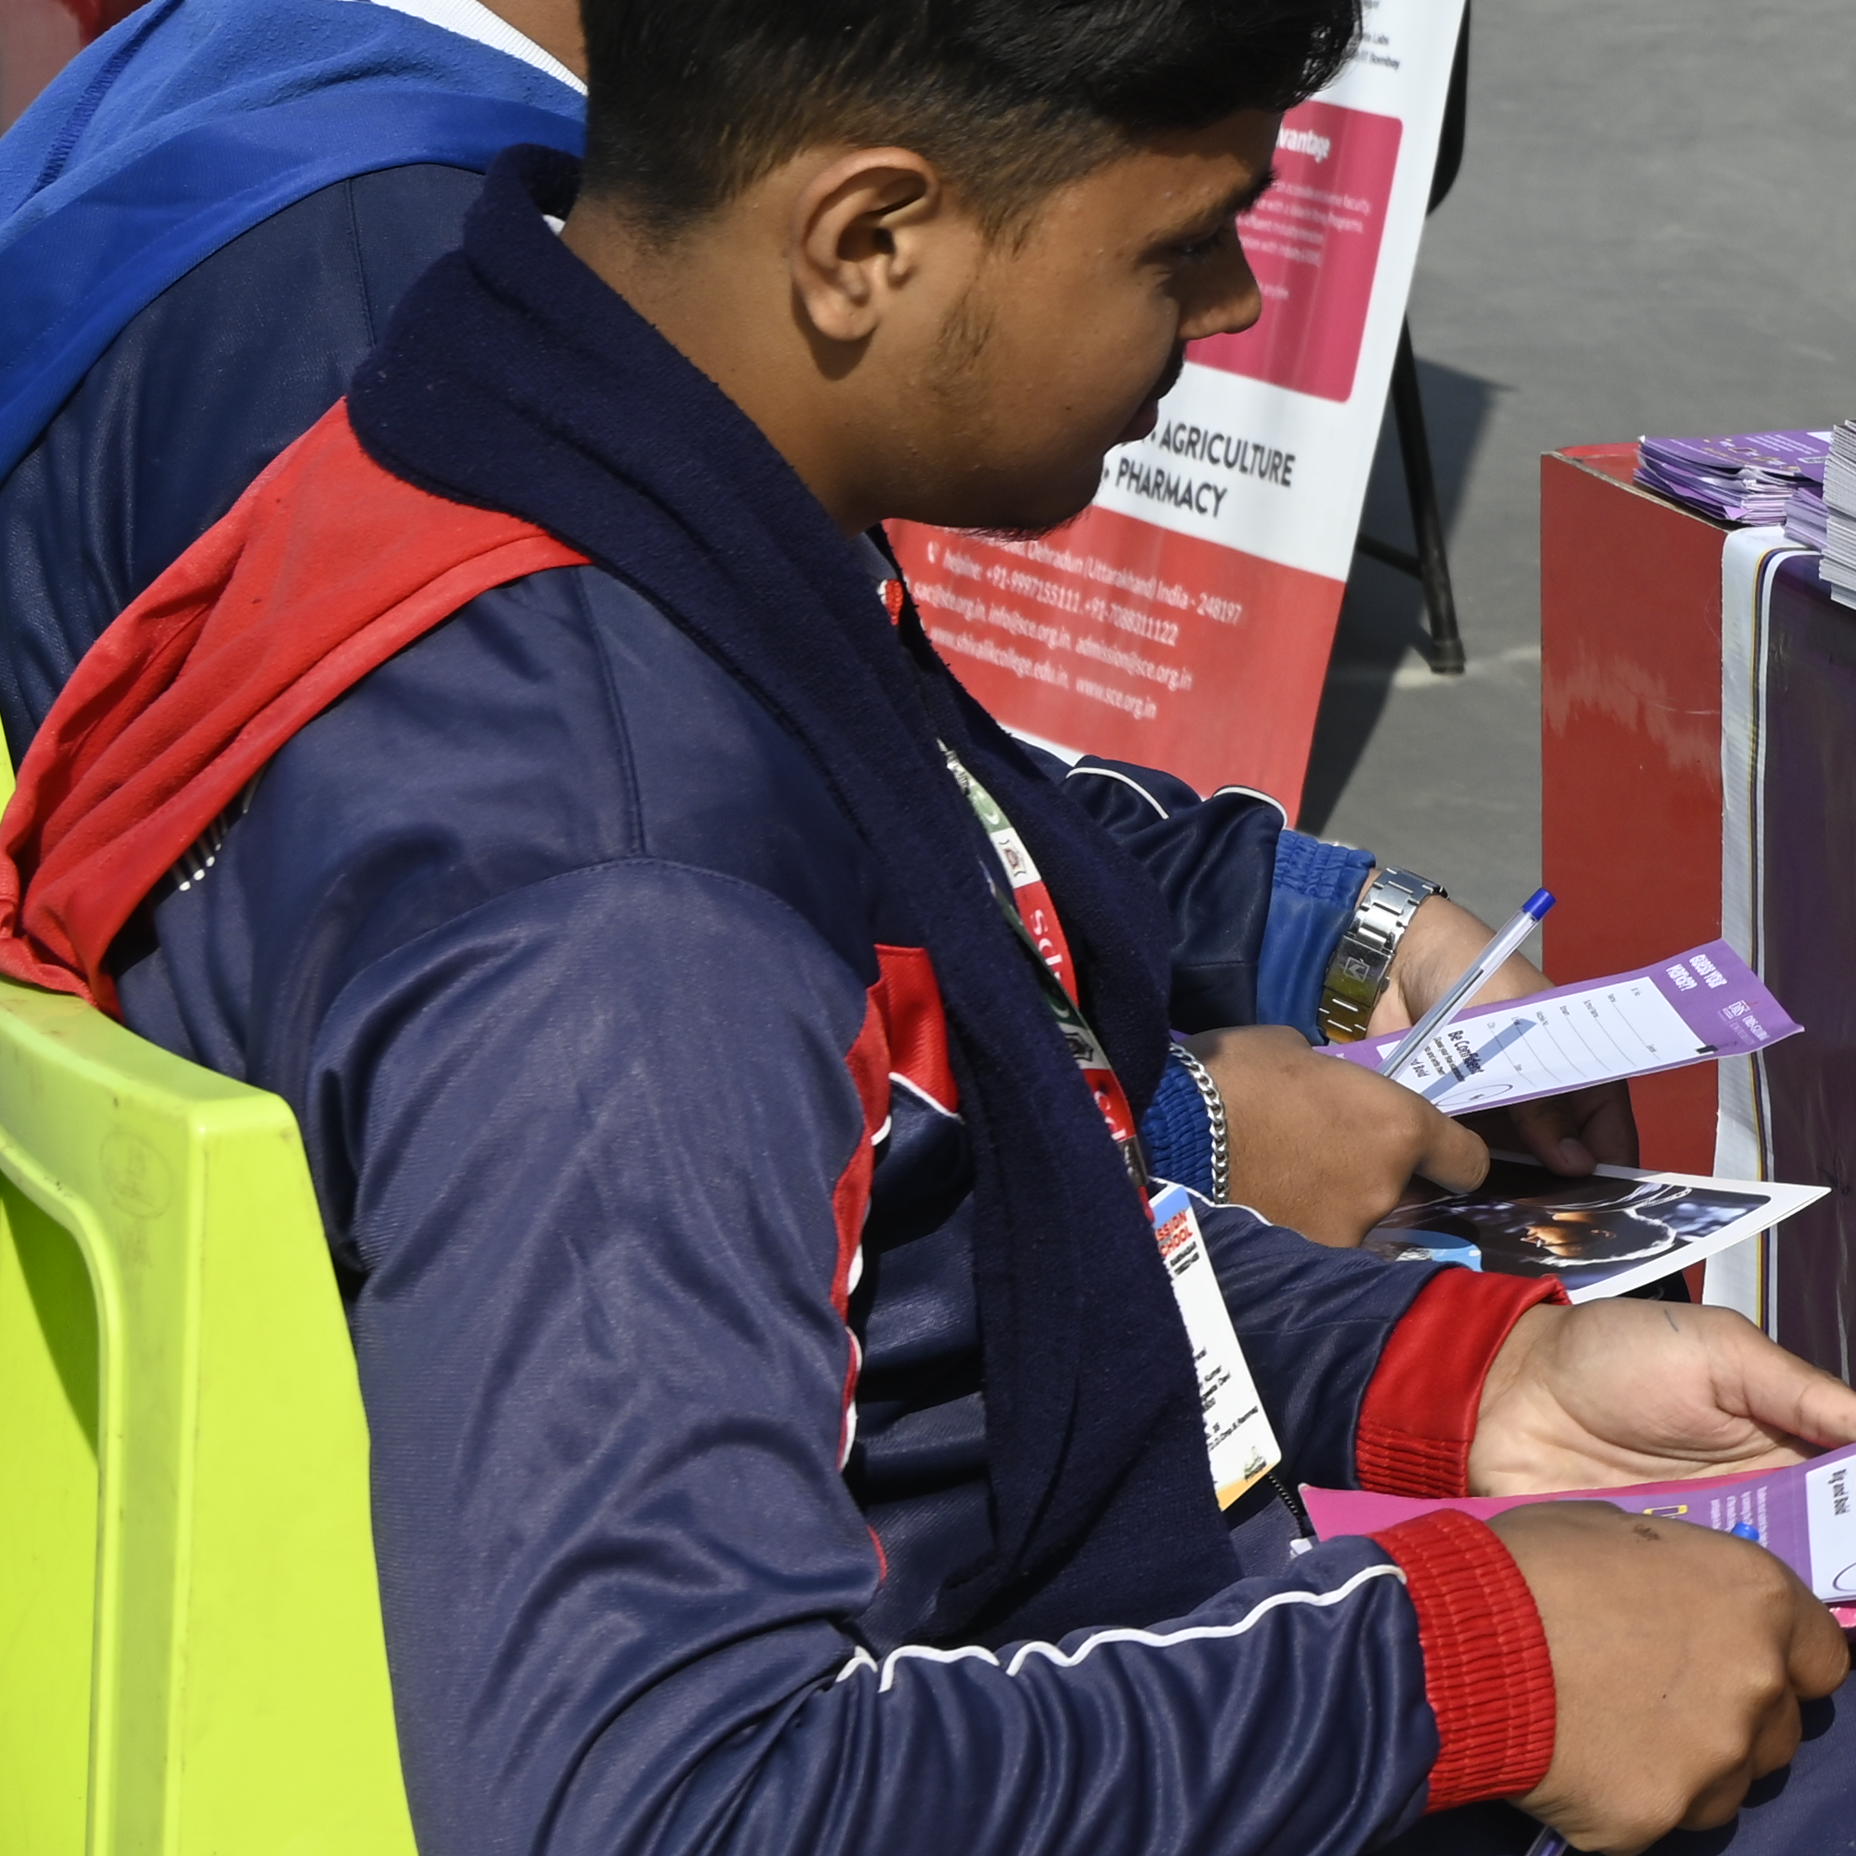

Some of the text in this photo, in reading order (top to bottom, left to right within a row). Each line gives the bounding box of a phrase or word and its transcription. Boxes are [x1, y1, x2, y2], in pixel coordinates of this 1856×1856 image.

[1276, 122, 1331, 164] vantage
[1159, 420, 1295, 488] AGRICULTURE
[1115, 457, 1228, 518] PHARMACY
[1027, 539, 1084, 573] Dehradun
[1157, 580, 1189, 611] India
[1197, 592, 1242, 625] 248197
[1689, 954, 1728, 989] GUESS YOUR
[1447, 1029, 1484, 1074] Be Confident
[1827, 1469, 1850, 1516] Big and Bold
